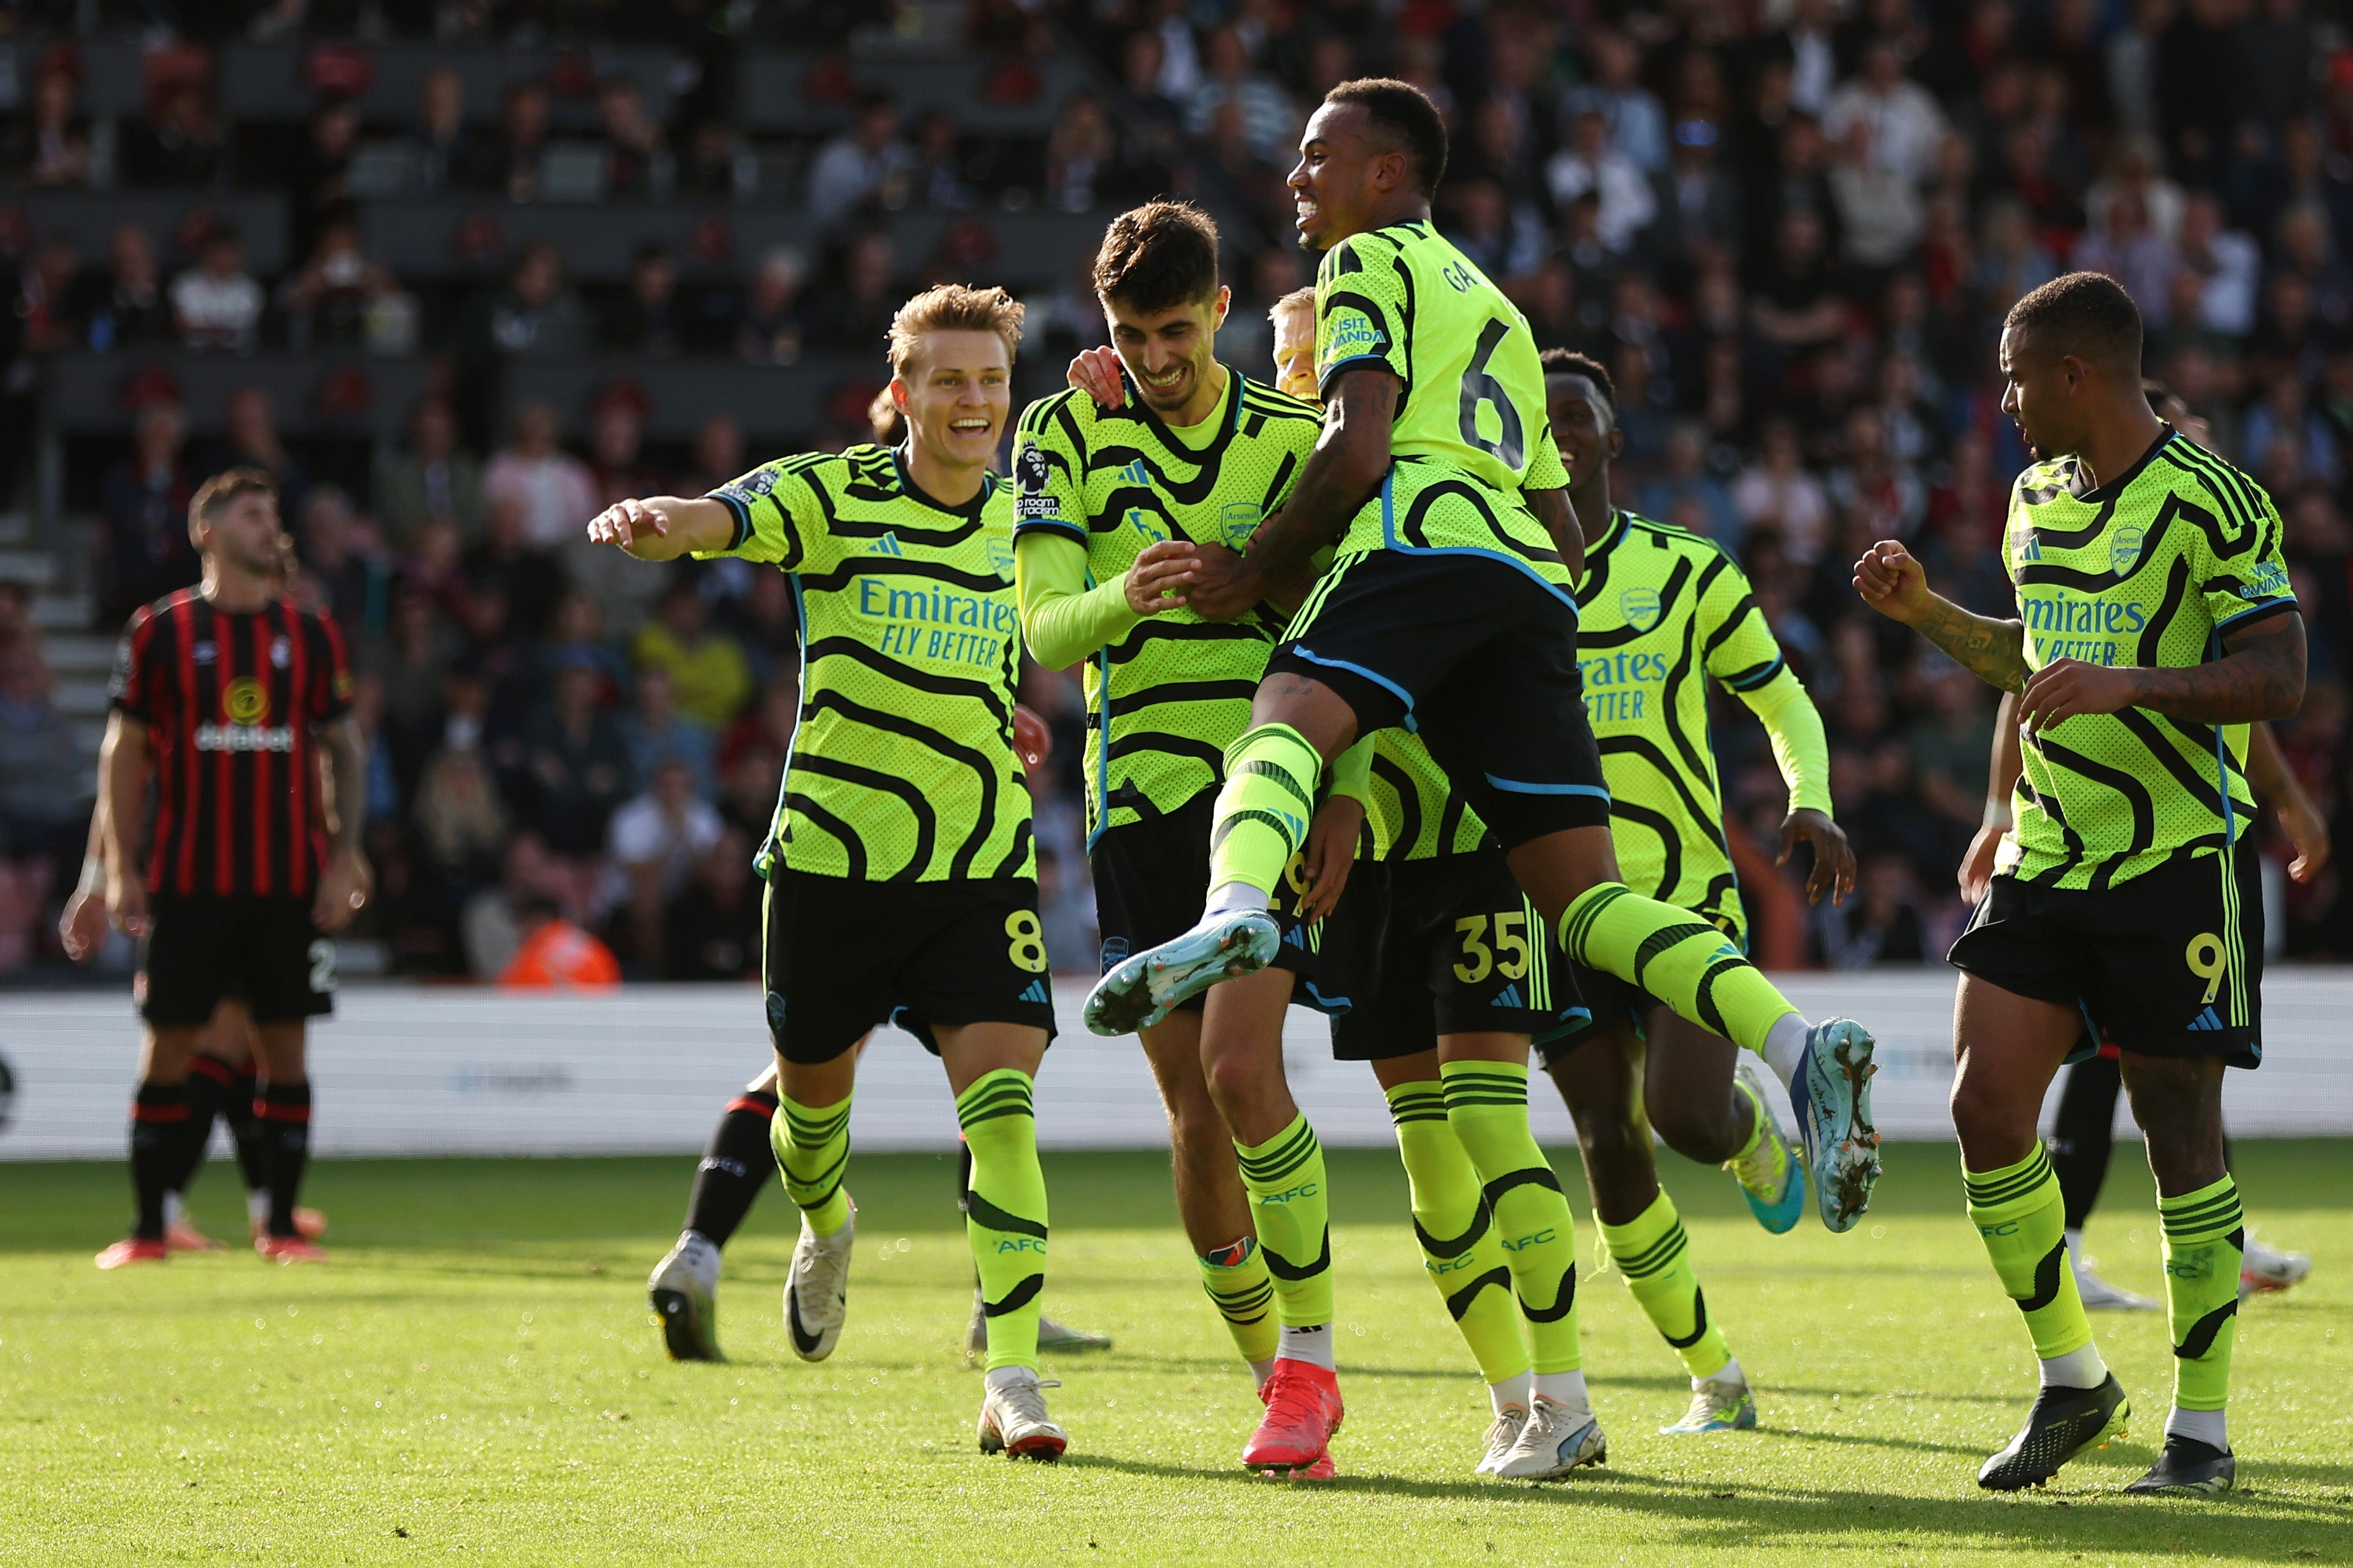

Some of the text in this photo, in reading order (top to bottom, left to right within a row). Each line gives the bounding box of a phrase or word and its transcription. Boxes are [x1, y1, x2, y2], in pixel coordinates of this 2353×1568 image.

[1459, 316, 1525, 471] 6
[1023, 506, 1060, 516] racism
[1024, 497, 1055, 507] room
[1228, 512, 1258, 520] Arsenal
[860, 578, 1018, 635] Emirates
[2017, 591, 2145, 633] mirates
[880, 624, 1000, 668] FLY BETTER
[1577, 650, 1667, 687] rates
[1584, 690, 1645, 723] ETTER
[1005, 909, 1047, 973] 8
[1454, 911, 1528, 984] 35
[2185, 933, 2226, 1004] 9
[1261, 1183, 1318, 1205] AFC
[1502, 1229, 1556, 1251] AFC
[1981, 1221, 2019, 1237] FC
[998, 1238, 1047, 1255] AFC
[1426, 1252, 1475, 1275] AFC
[2166, 1263, 2198, 1279] FC
